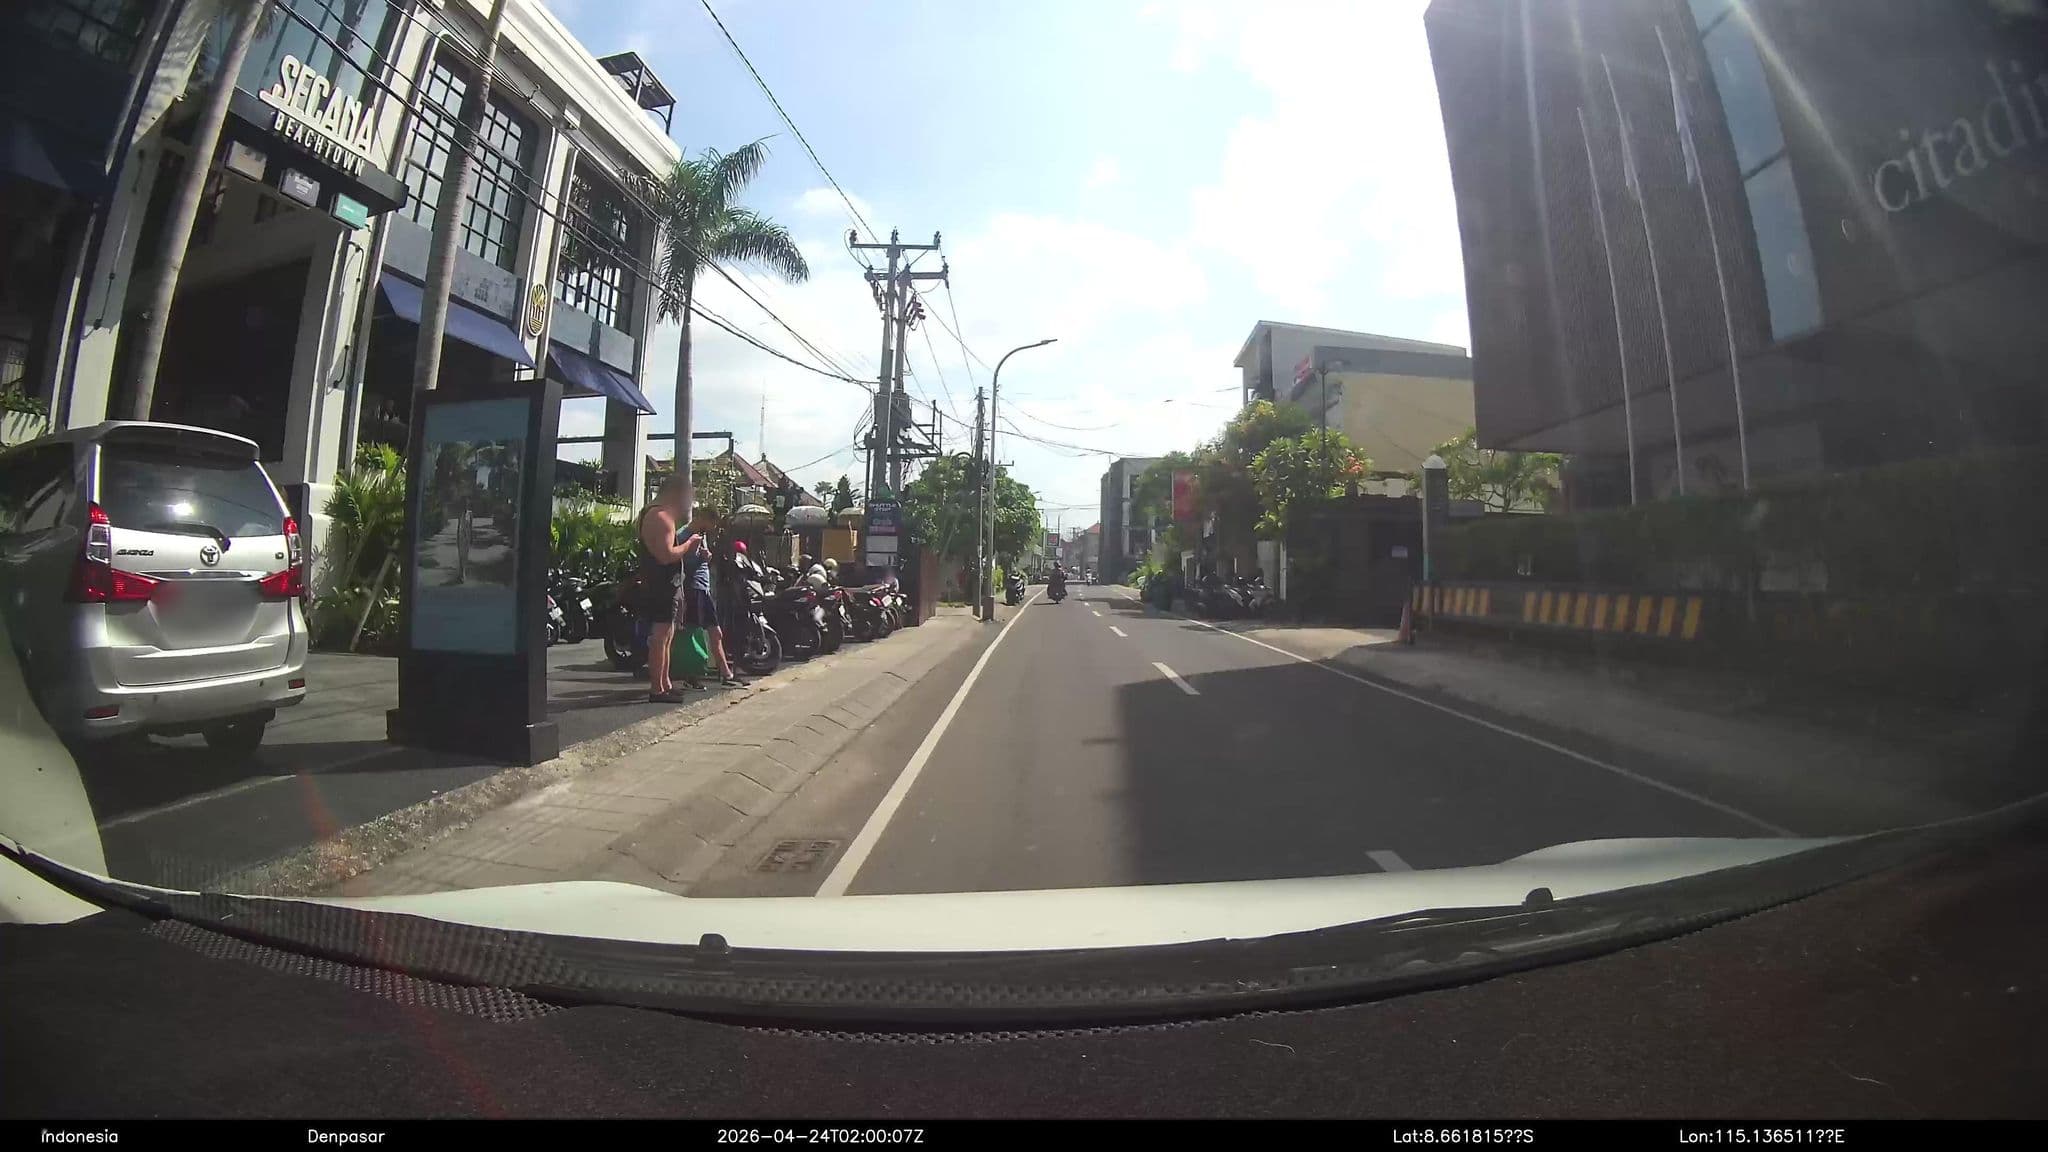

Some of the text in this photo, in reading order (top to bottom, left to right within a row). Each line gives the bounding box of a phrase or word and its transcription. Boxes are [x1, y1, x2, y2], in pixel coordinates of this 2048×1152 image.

[264, 54, 380, 160] SECANA
[272, 110, 366, 176] BEACHTOWN
[1873, 58, 2048, 212] citadi
